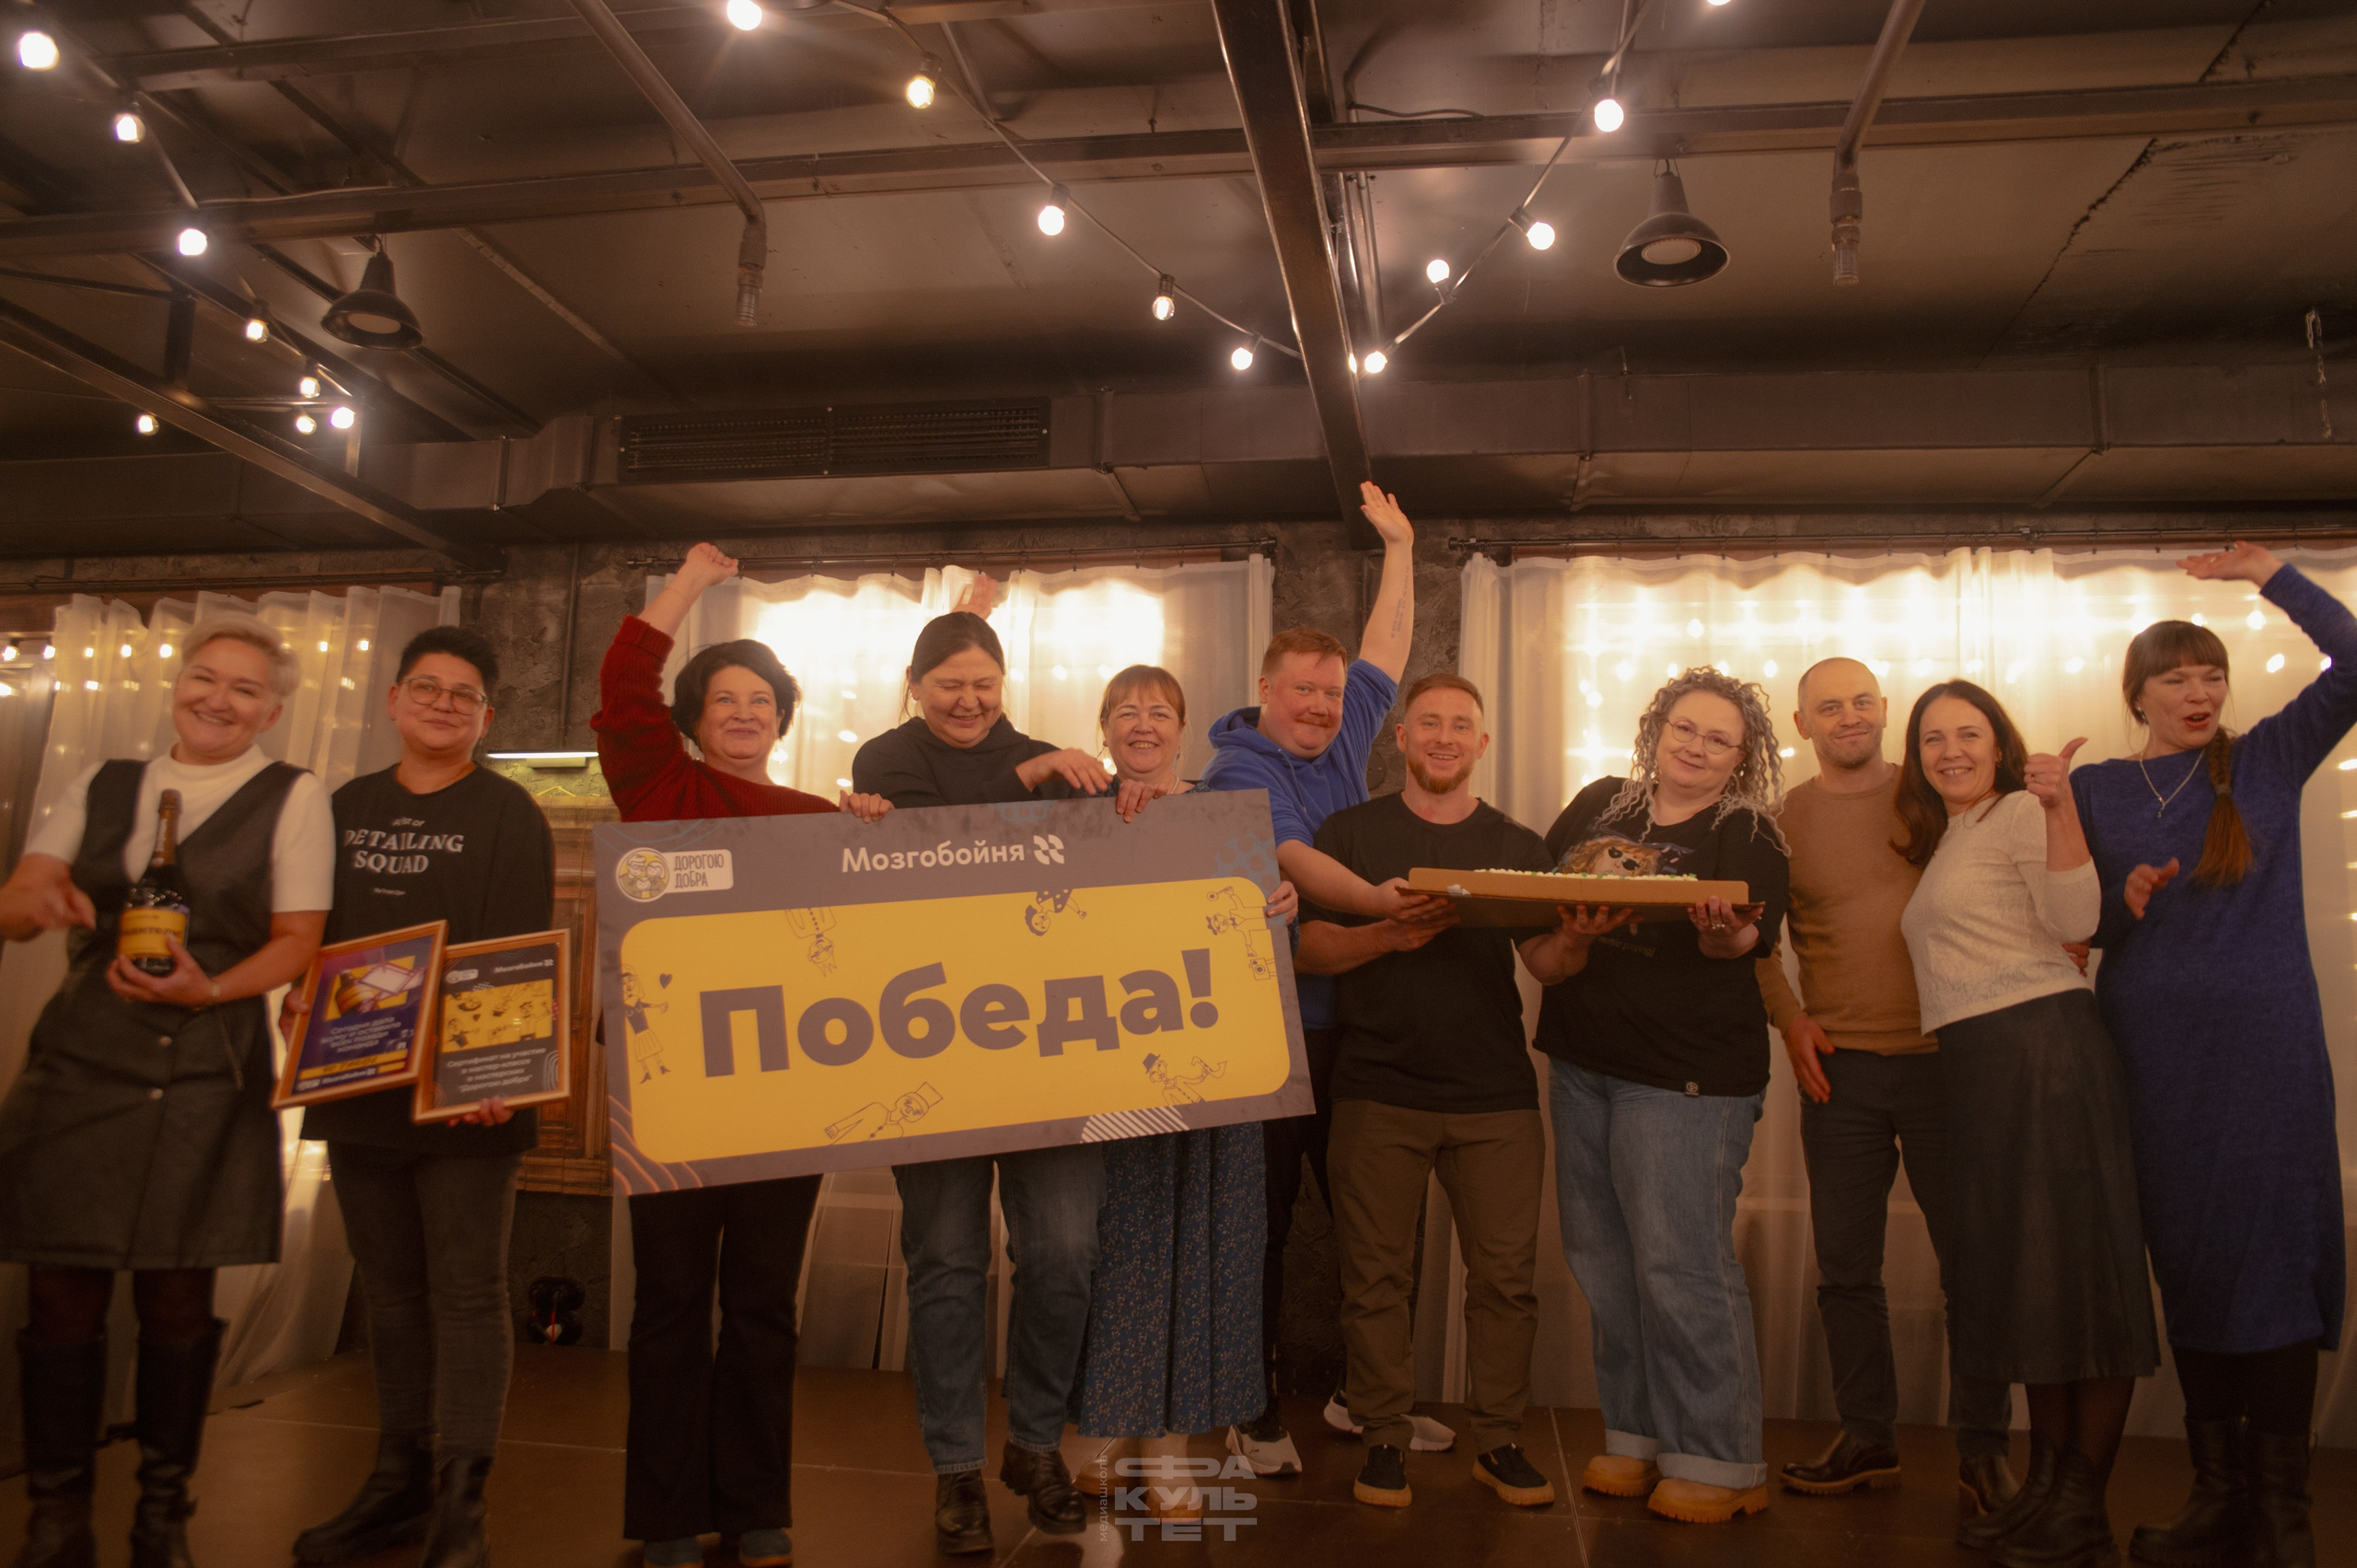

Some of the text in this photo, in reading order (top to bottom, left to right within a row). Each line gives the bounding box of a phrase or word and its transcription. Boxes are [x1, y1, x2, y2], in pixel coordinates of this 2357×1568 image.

[343, 829, 464, 853] DETAILING
[354, 850, 429, 874] SQUAD
[674, 854, 725, 871] ДОРОГОЮ
[842, 840, 1026, 873] Мозгобойня
[674, 870, 709, 889] ДОБРА
[699, 947, 1219, 1078] Победа!
[447, 1048, 547, 1068] Сертификат на участие
[468, 1058, 532, 1074] мастер-классе
